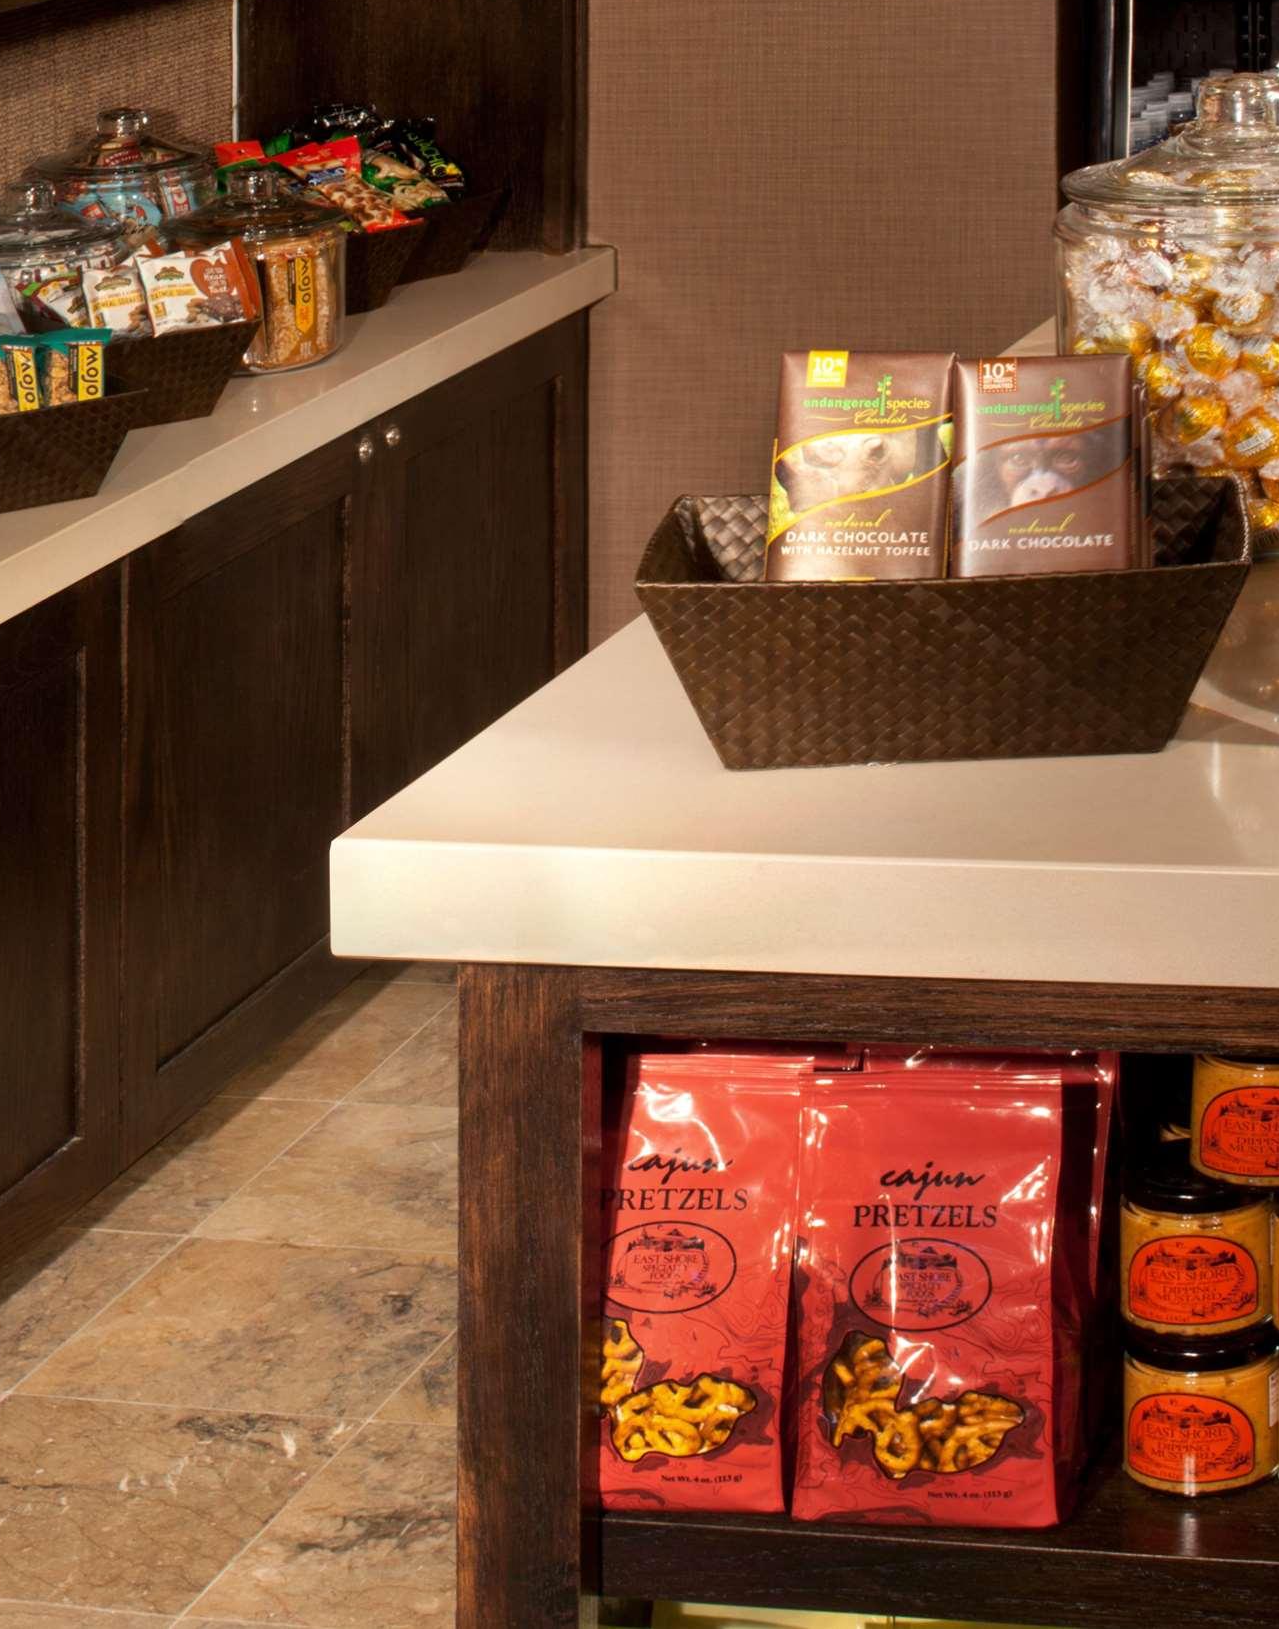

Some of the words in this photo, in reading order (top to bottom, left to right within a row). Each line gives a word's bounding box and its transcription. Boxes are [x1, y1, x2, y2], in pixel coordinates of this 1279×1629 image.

[803, 397, 880, 411] endangered
[886, 397, 932, 413] species
[824, 509, 893, 528] natural
[786, 531, 826, 544] DARK
[833, 531, 929, 545] CHOCOLATE
[969, 538, 1011, 551] DARK
[1017, 534, 1114, 550] CHOCOLATE
[781, 546, 813, 556] WITH
[816, 546, 880, 557] HAZELNUT
[885, 546, 932, 557] TOFFEE
[1224, 1121, 1258, 1132] EAST
[627, 1148, 734, 1185] cajun
[880, 1162, 986, 1201] cajun
[853, 1204, 998, 1229] PRETZELS
[634, 1254, 661, 1265] EAST
[664, 1253, 699, 1265] SHORE
[661, 1475, 675, 1483] Net
[677, 1475, 692, 1483] Wt.
